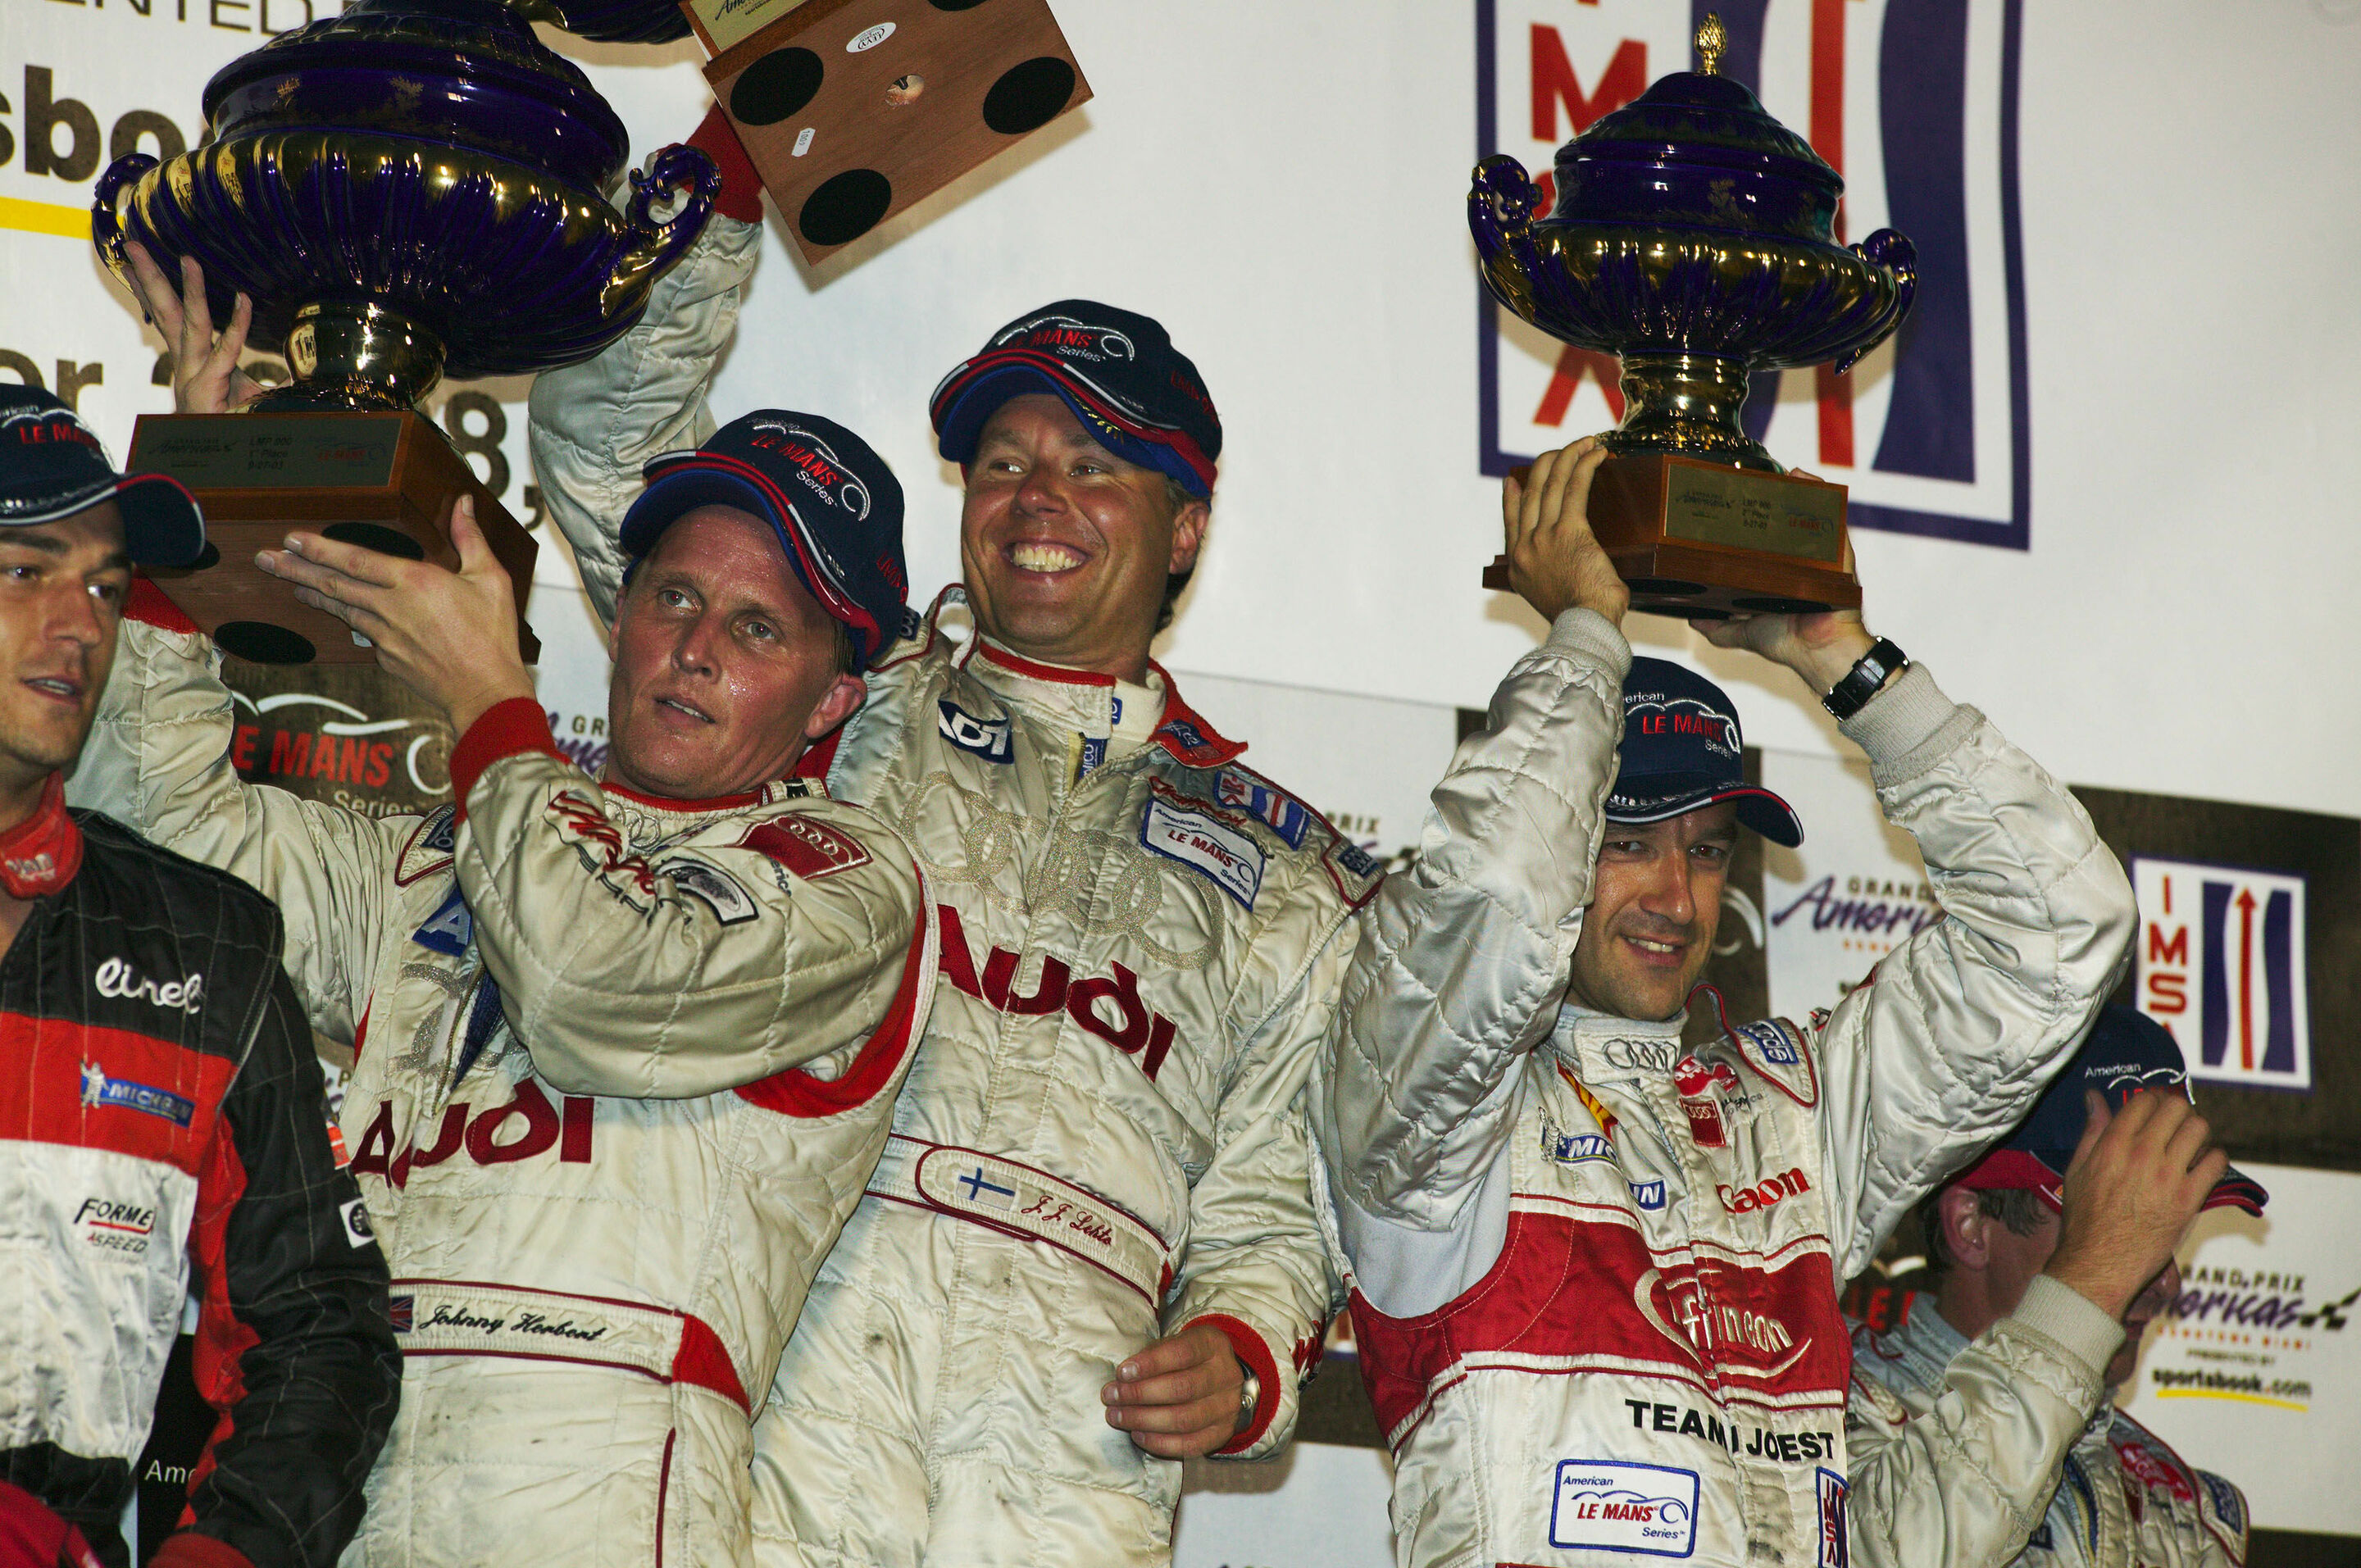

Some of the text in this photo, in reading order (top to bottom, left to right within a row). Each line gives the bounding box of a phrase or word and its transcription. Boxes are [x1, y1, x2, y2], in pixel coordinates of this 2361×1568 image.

[1030, 329, 1094, 348] MANS
[20, 425, 46, 444] LE
[750, 434, 837, 486] LE MANS
[796, 470, 834, 506] Series
[1623, 693, 1665, 705] erican
[1642, 716, 1667, 735] LE
[269, 729, 394, 788] MANS
[1154, 808, 1203, 829] American
[1167, 829, 1235, 868] LE MANS
[1220, 869, 1250, 895] Series
[2084, 1063, 2141, 1079] American
[73, 1198, 157, 1229] FORME
[2254, 1270, 2305, 1293] PRIX
[419, 1304, 505, 1335] Johnny
[2152, 1368, 2313, 1398] sportsbook.com
[1745, 1427, 1835, 1462] JOEST
[1563, 1475, 1614, 1487] American
[1576, 1502, 1654, 1523] LE MANS
[1641, 1526, 1679, 1539] Series
